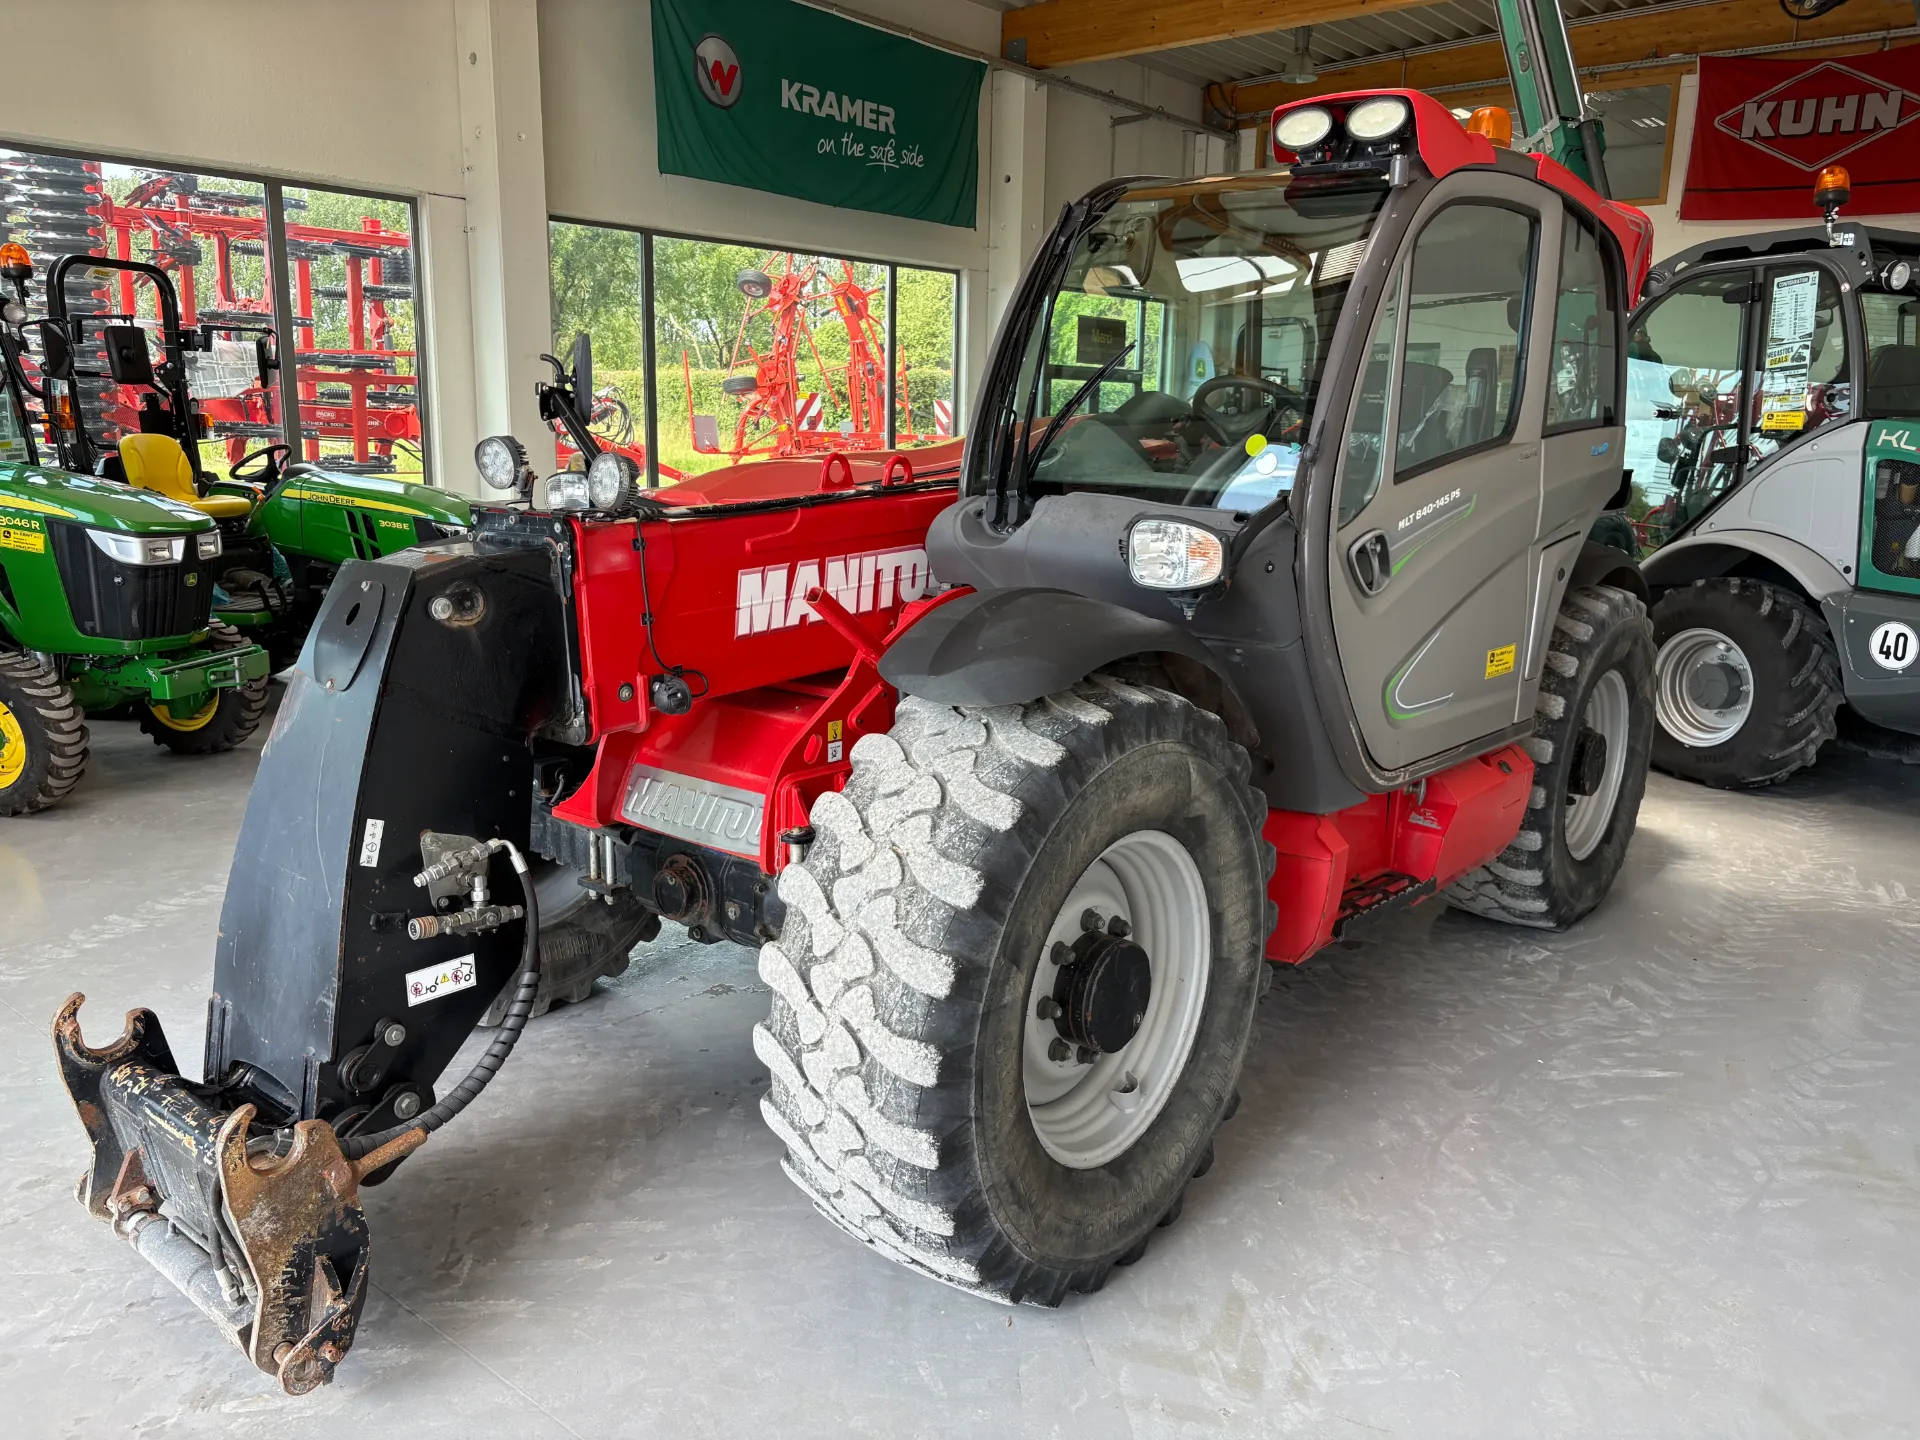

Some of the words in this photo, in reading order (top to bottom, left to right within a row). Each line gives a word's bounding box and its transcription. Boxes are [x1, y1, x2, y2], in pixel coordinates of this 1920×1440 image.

[781, 78, 896, 135] KRAMER
[1740, 90, 1903, 139] KUHN
[817, 138, 837, 155] on
[841, 131, 866, 157] the
[867, 138, 899, 172] safe
[900, 144, 925, 168] side
[1769, 355, 1788, 366] DEALS
[307, 492, 329, 503] JOHN
[329, 494, 356, 506] DEERE
[1398, 512, 1415, 531] MLT
[1416, 493, 1450, 520] 840-145
[1450, 488, 1461, 501] PS
[735, 544, 943, 640] MANITO
[1879, 630, 1908, 662] 40
